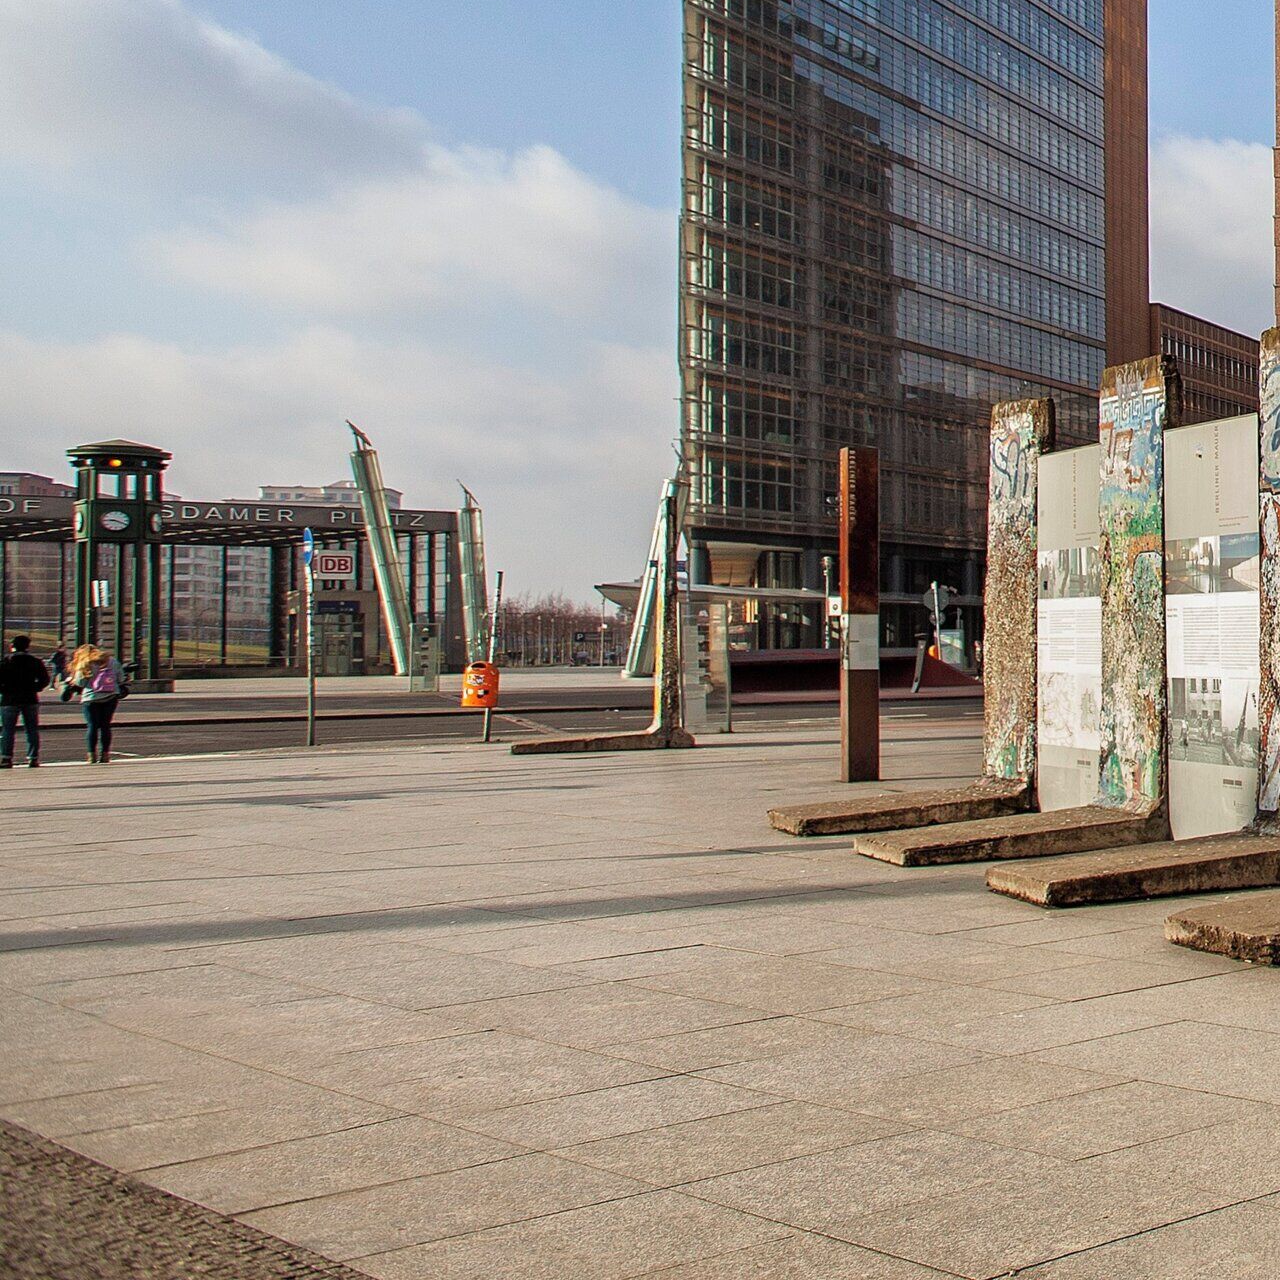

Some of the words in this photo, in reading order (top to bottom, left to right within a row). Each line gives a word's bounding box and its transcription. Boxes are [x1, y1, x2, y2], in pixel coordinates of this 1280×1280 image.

[161, 505, 294, 522] SDAMER
[330, 511, 425, 526] PLTZ
[324, 558, 349, 571] DB
